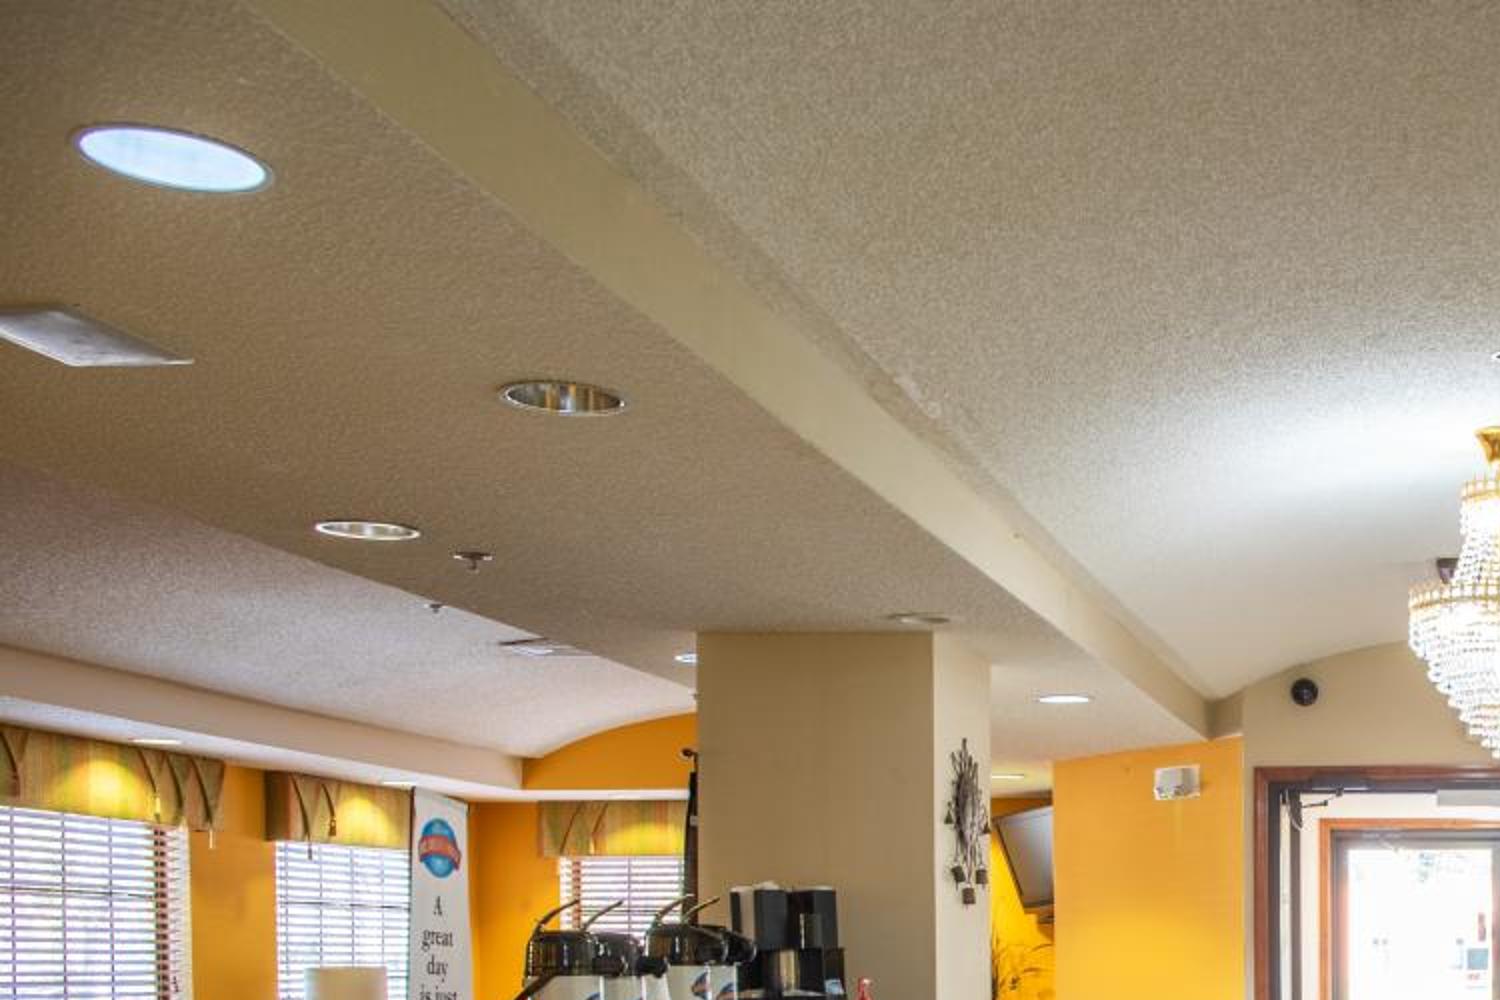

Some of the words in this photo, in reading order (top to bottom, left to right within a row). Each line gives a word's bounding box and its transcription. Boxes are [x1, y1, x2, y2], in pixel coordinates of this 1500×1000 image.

[433, 895, 443, 915] A
[421, 930, 454, 952] great
[426, 954, 448, 982] day
